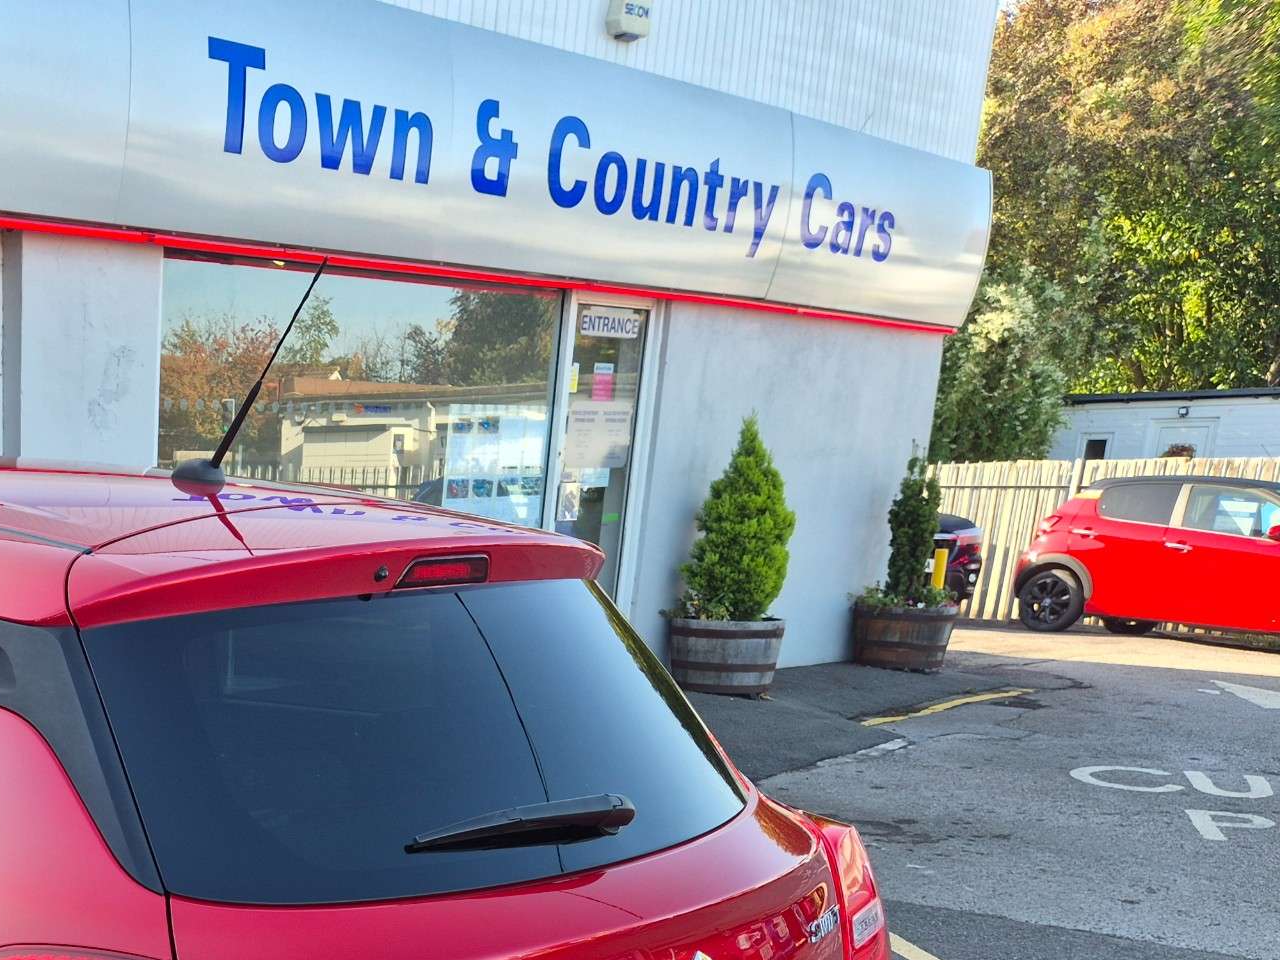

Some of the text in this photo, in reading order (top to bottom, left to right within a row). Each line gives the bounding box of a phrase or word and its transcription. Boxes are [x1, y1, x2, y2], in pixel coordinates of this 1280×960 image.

[208, 37, 895, 262] Town & Country Cars
[581, 314, 639, 336] ENTRANCE
